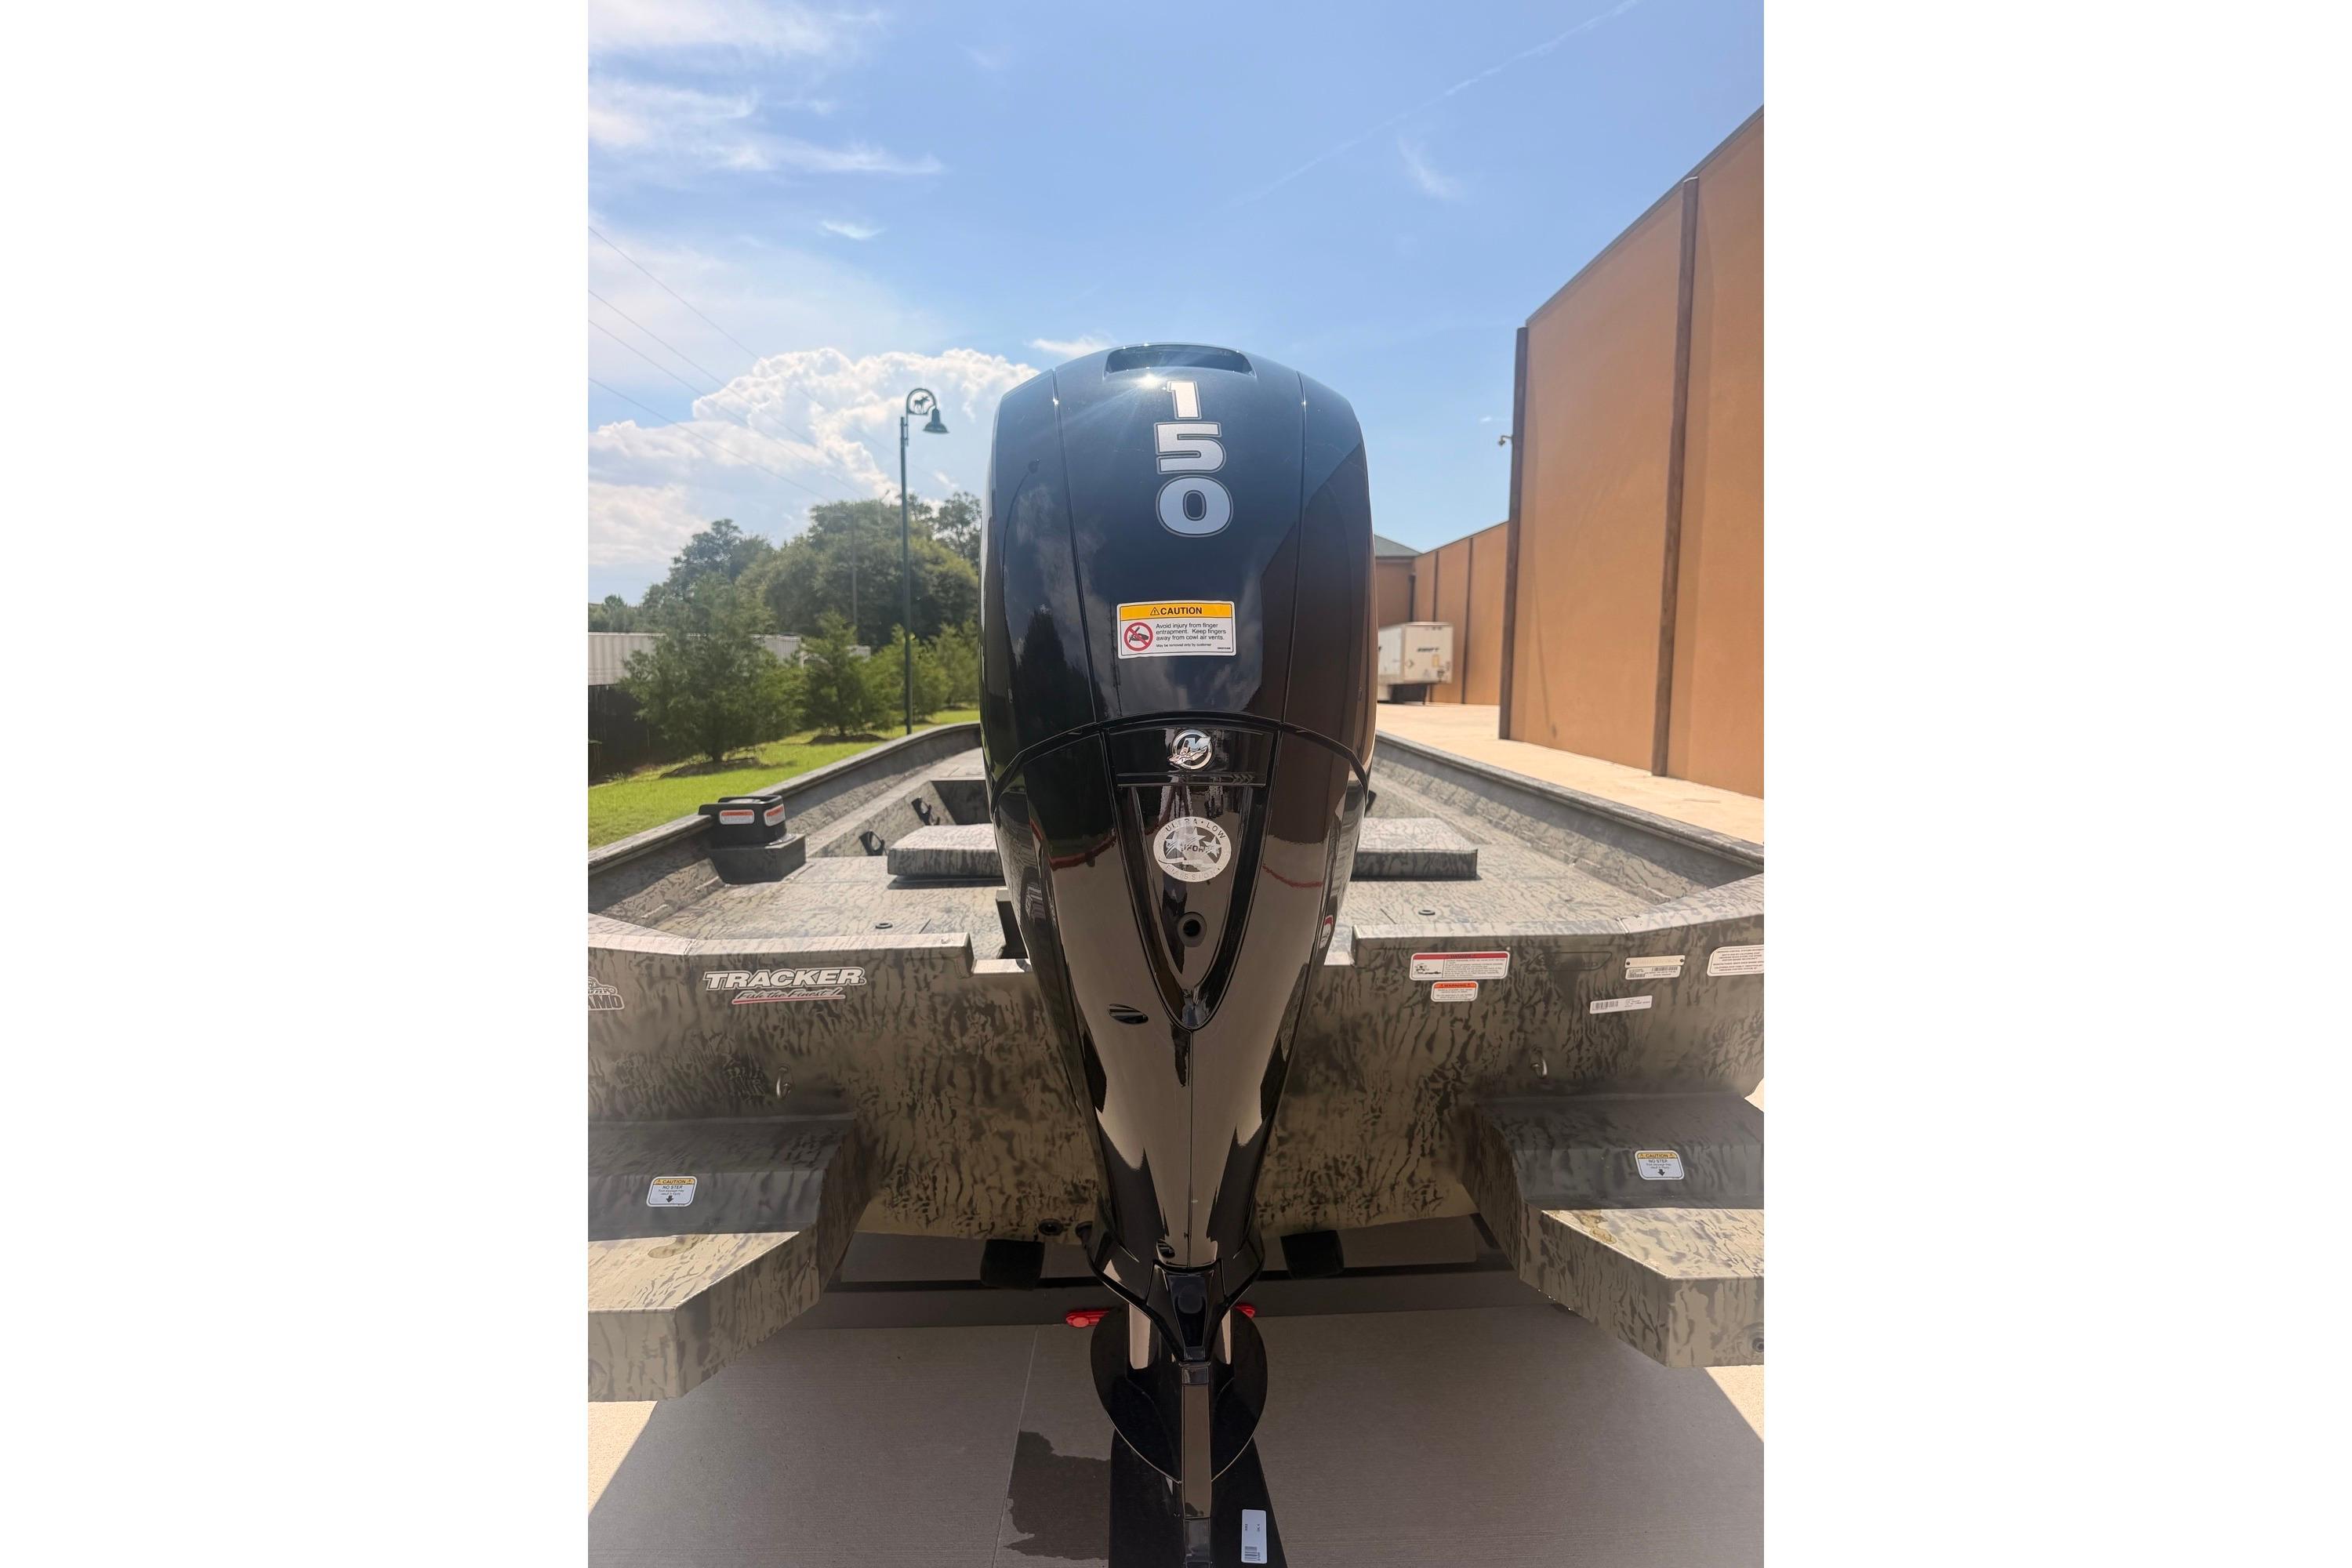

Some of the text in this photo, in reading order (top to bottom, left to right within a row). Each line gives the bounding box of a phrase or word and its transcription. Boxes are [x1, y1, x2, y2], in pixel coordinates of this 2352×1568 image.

[1160, 607, 1203, 615] CAUTION
[1206, 822, 1226, 839] LOW
[705, 968, 864, 989] TRACKER
